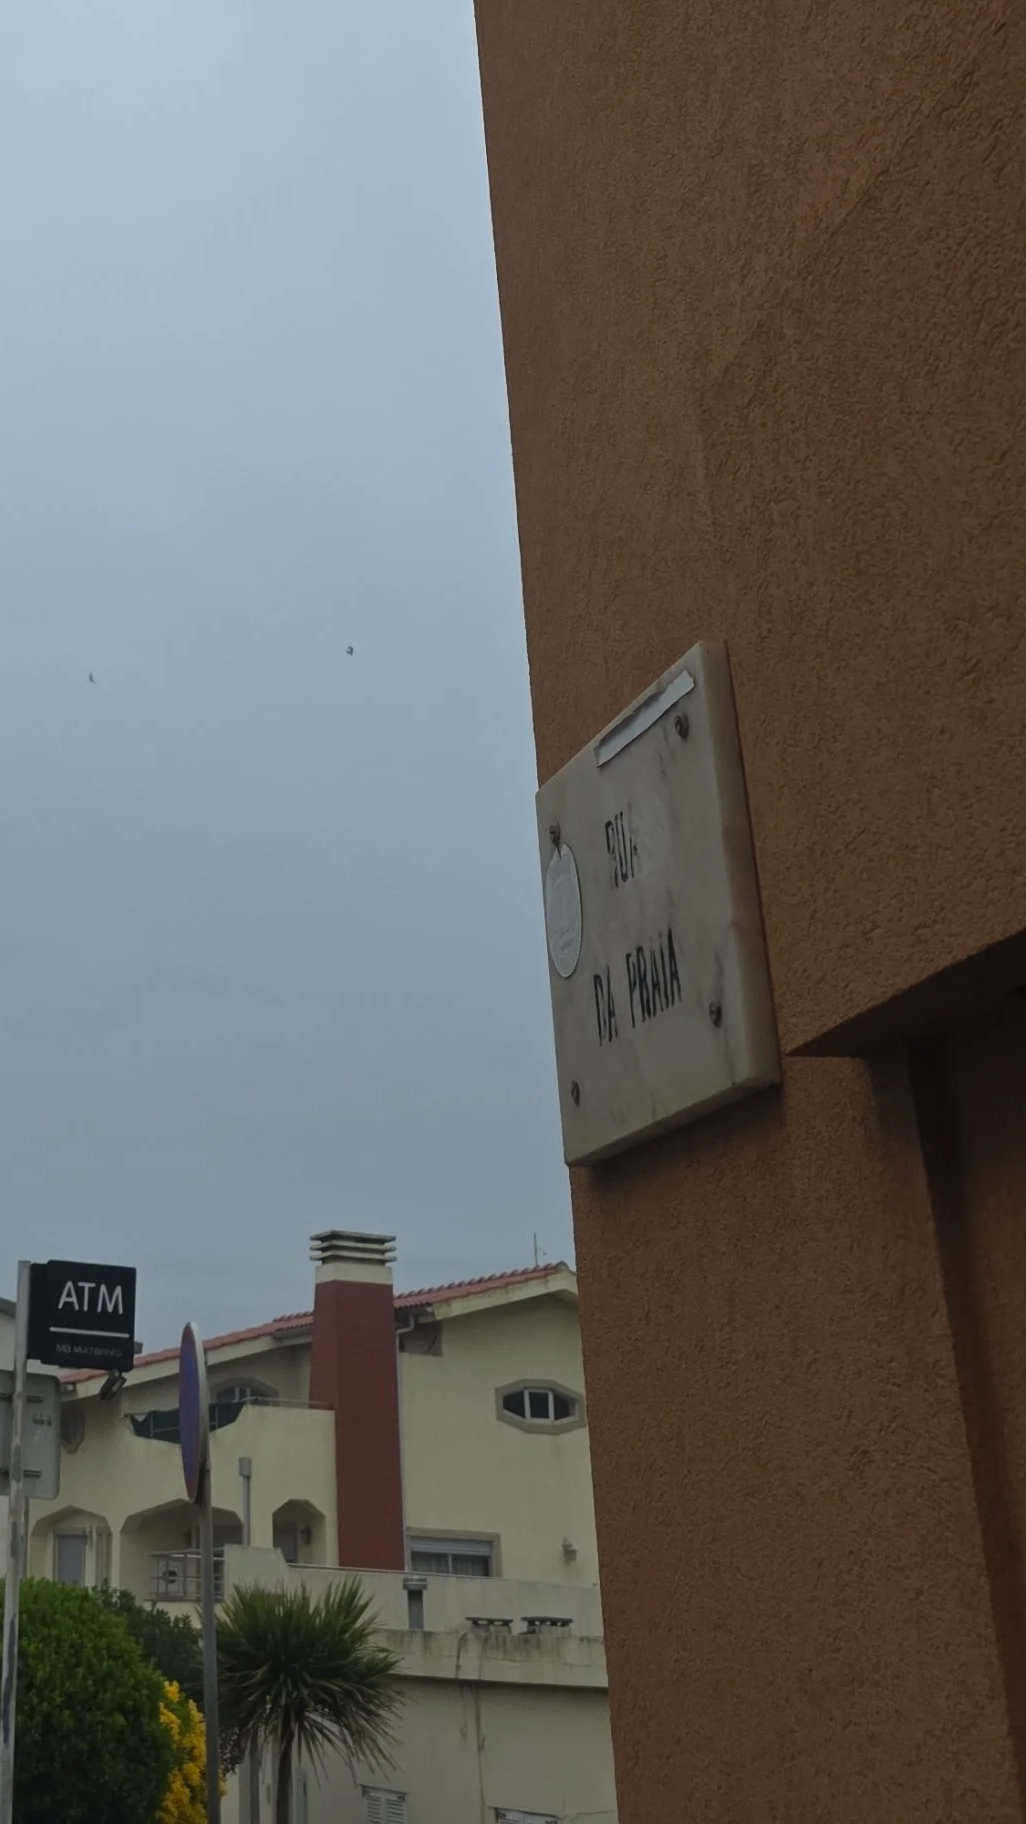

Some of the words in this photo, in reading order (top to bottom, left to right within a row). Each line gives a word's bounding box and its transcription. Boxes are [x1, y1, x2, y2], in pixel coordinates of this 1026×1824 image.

[593, 964, 618, 1047] DA
[625, 925, 682, 1029] PRAIA
[57, 1280, 124, 1315] ATM
